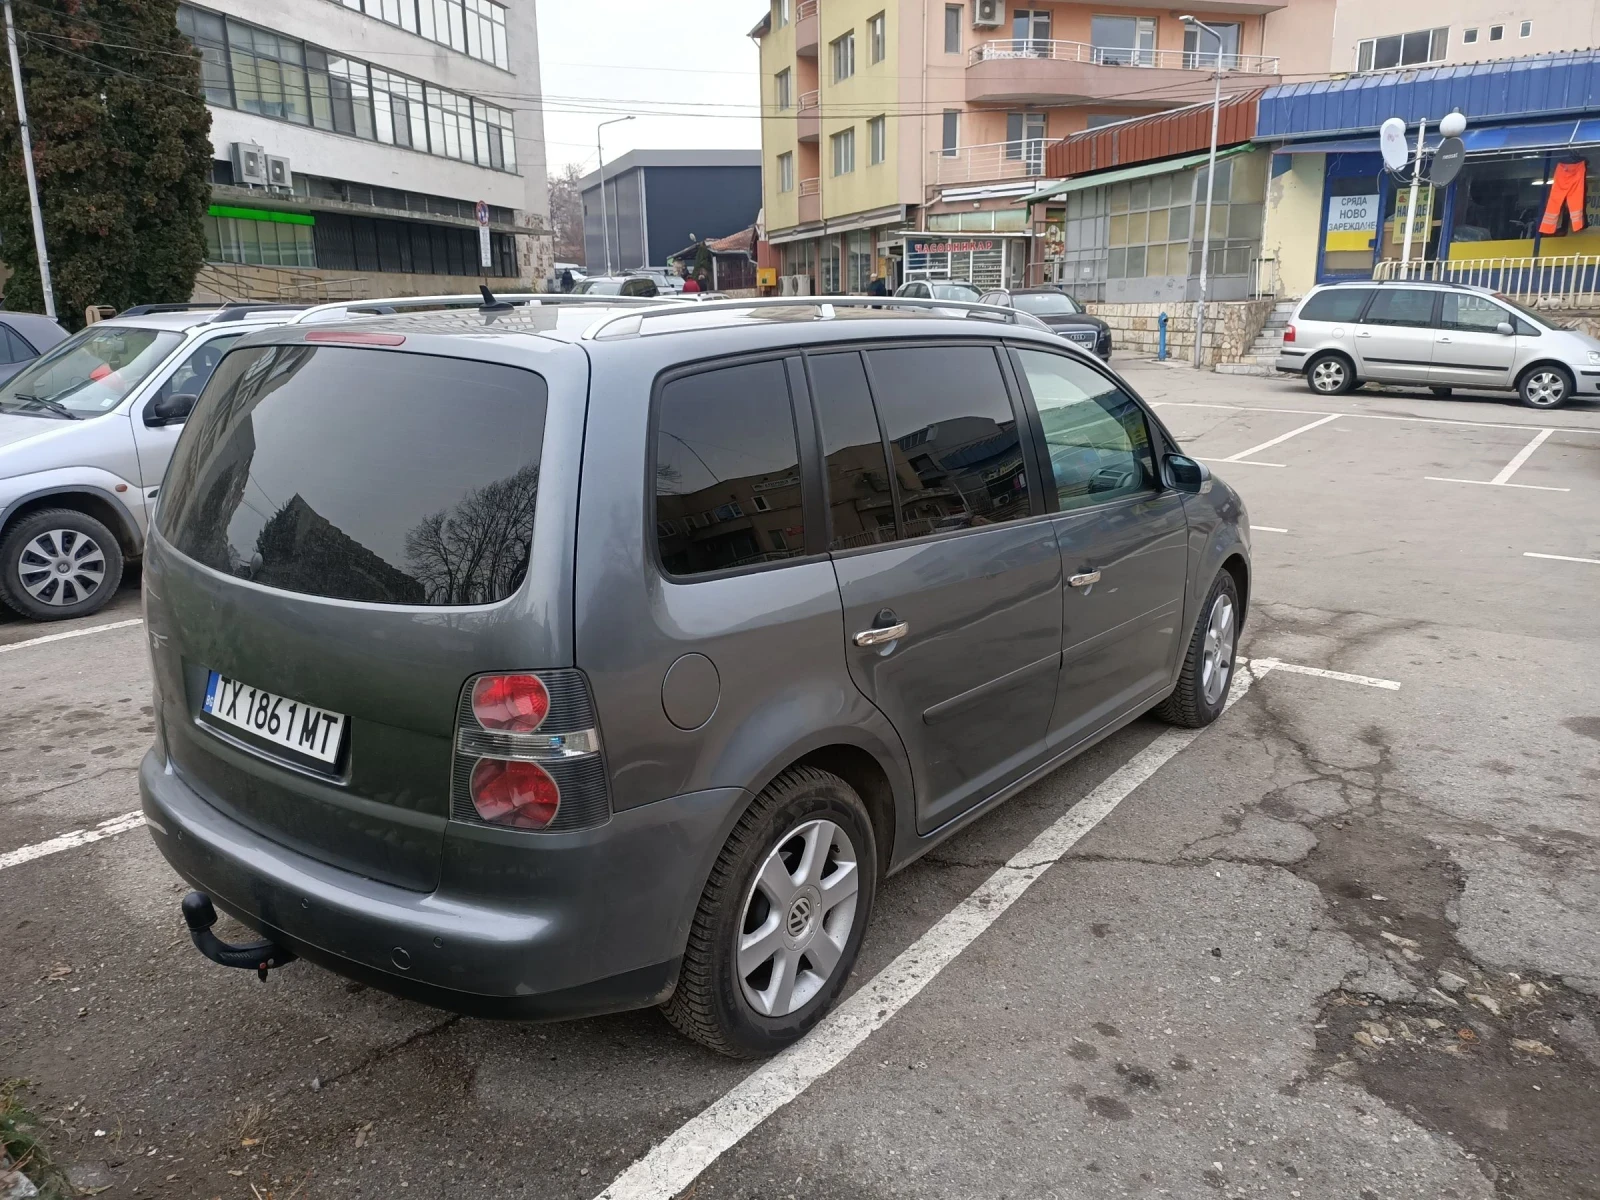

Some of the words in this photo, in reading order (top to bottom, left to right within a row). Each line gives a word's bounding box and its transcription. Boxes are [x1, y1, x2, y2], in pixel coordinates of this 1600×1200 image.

[1341, 196, 1367, 206] СРЯДА
[1339, 208, 1367, 219] НОВО
[915, 241, 993, 253] ЧАСОВНИКАР
[205, 694, 214, 707] BG
